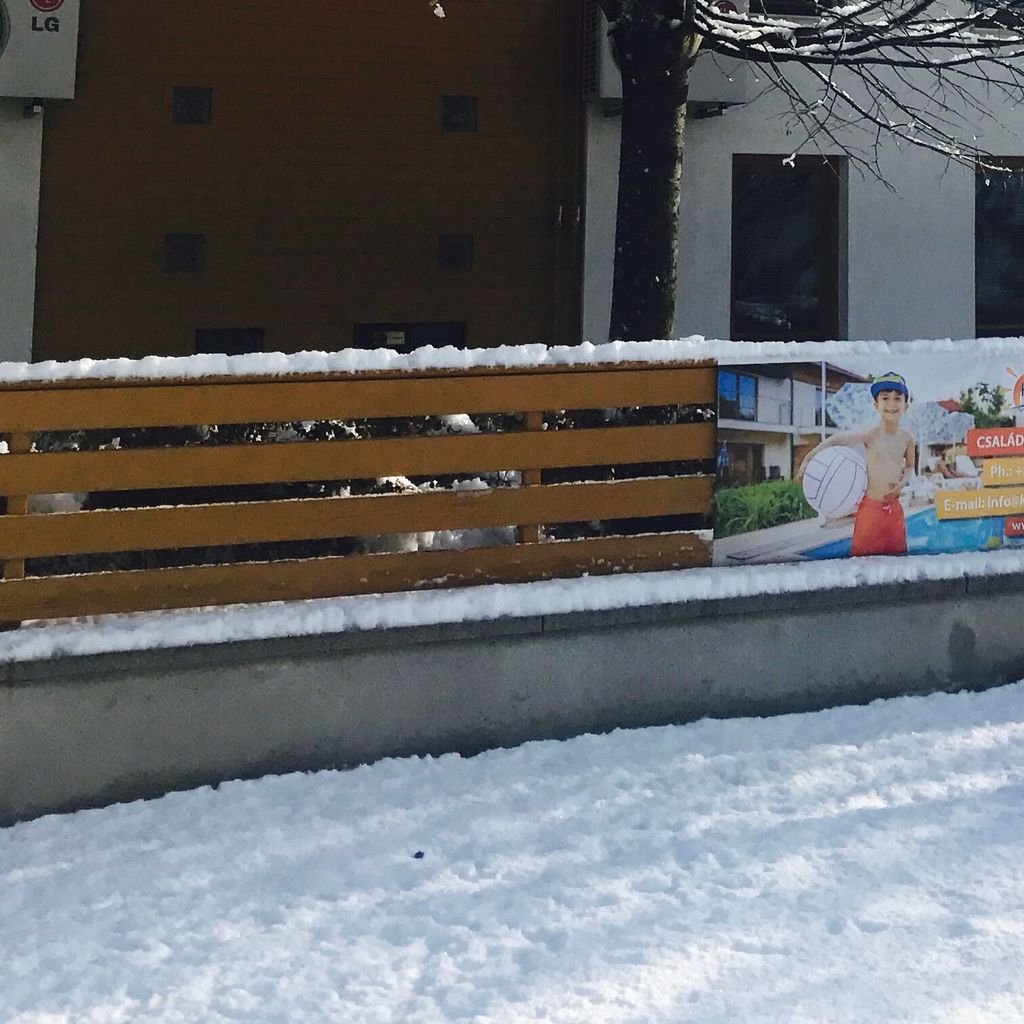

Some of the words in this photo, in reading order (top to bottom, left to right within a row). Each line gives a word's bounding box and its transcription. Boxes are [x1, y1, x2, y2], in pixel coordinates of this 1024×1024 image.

[31, 16, 60, 32] LG
[990, 464, 1013, 478] Ph.:
[943, 496, 985, 511] E-mail:
